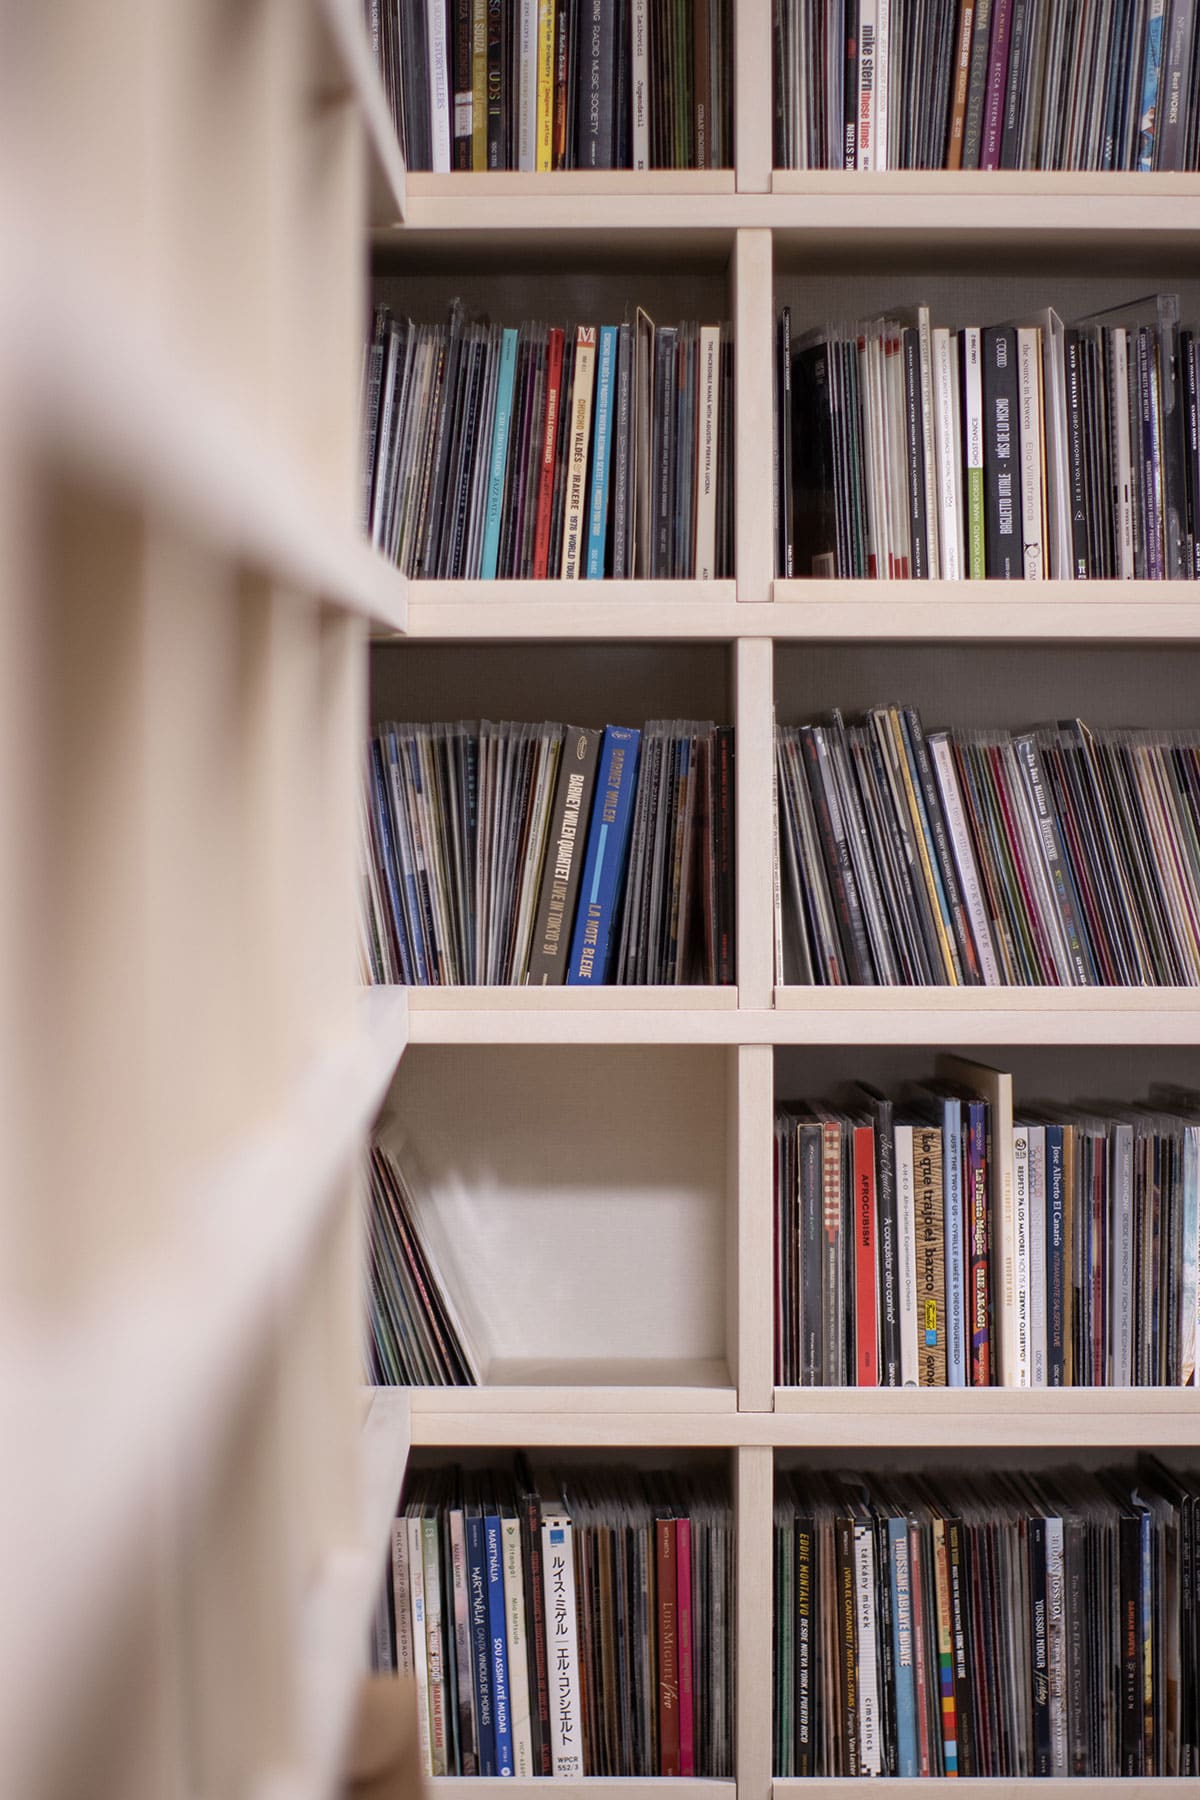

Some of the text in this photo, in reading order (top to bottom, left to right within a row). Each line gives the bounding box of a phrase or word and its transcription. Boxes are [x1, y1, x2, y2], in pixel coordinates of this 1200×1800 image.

[474, 24, 485, 54] SOUZA
[592, 25, 601, 56] RADIO
[591, 60, 600, 89] MUSIC
[860, 25, 876, 149] mike stern these times
[590, 92, 600, 135] SOCIETY
[967, 46, 985, 155] BECCA STEVENS
[988, 63, 1002, 153] BECCA STEVENS BAND
[1169, 72, 1181, 124] Best WORKS
[846, 124, 856, 153] STERN
[1023, 344, 1033, 430] the source in between
[971, 418, 979, 441] DANCE
[996, 398, 1013, 534] BAGLIETTO DE LO MISMO
[1026, 442, 1034, 521] Elio Villafranca
[493, 478, 502, 496] JAZZ
[565, 399, 587, 579] CHUCHO VALDÉS IRAKERE WORLD TOUR
[911, 713, 958, 903] POLYDOR STEREO THE TONY WILLIAMS LIFETIME
[545, 774, 585, 941] BARNEY WILEN QUARTET LIVE IN TOKYO
[578, 749, 625, 978] BARNEY WILEN LA NOTE BLEUE
[969, 877, 990, 949] TOKYO LIVE
[922, 1133, 935, 1152] Lo
[950, 1134, 958, 1153] JUST
[920, 1158, 933, 1185] que
[951, 1174, 959, 1191] TWO
[1017, 1166, 1025, 1196] RESPETO
[1052, 1166, 1062, 1199] Alberto
[861, 1174, 871, 1247] AFROCUBISM
[922, 1190, 936, 1225] trajo
[951, 1193, 959, 1203] OF
[952, 1205, 959, 1216] US
[974, 1168, 985, 1255] La Flauta Mágica
[1053, 1201, 1062, 1210] El
[924, 1228, 936, 1242] el
[952, 1223, 960, 1256] CYRILLE
[1018, 1223, 1026, 1256] MAYORES
[1053, 1212, 1062, 1246] Canario
[883, 1226, 895, 1288] conquistar otro
[903, 1236, 911, 1277] Experimental
[924, 1248, 937, 1291] barco
[952, 1258, 961, 1282] AIMÉE
[976, 1268, 986, 1328] RIE AKAGI
[1053, 1300, 1061, 1331] SALSERO
[953, 1318, 961, 1365] FIGUEIREDO
[1018, 1321, 1026, 1362] ADALBERTO
[1053, 1332, 1061, 1347] LIVE
[1120, 1329, 1128, 1368] BEGINNING
[799, 1533, 809, 1562] EDDIE
[454, 1565, 462, 1588] MARTINI
[799, 1564, 809, 1616] MONTALVO
[844, 1590, 852, 1598] EL
[895, 1536, 912, 1666] THIOSSANE ABLAYE NDIAYE
[1051, 1575, 1062, 1620] YOUSSOU
[799, 1618, 809, 1642] DESDE
[1127, 1601, 1136, 1630] DAMIAN
[494, 1638, 503, 1655] SOU
[1035, 1600, 1046, 1668] YOUSSOU NDOUR
[496, 1657, 505, 1683] ASSIM
[659, 1602, 678, 1709] LUIS MIGUEL Vivo
[799, 1643, 809, 1667] NUEVA
[846, 1649, 854, 1667] MTG
[475, 1627, 491, 1725] CANTA VINICIUS DE MORAES
[497, 1685, 507, 1700] ATÉ
[800, 1669, 809, 1688] YORK
[847, 1668, 855, 1707] ALL-STARS
[556, 1648, 573, 1746] エル・コンシエルト
[800, 1696, 809, 1724] PUERTO
[431, 1683, 444, 1748] HABANA DREAMS
[498, 1702, 507, 1733] MUDAR
[800, 1725, 809, 1743] RICO
[849, 1754, 857, 1776] Lester
